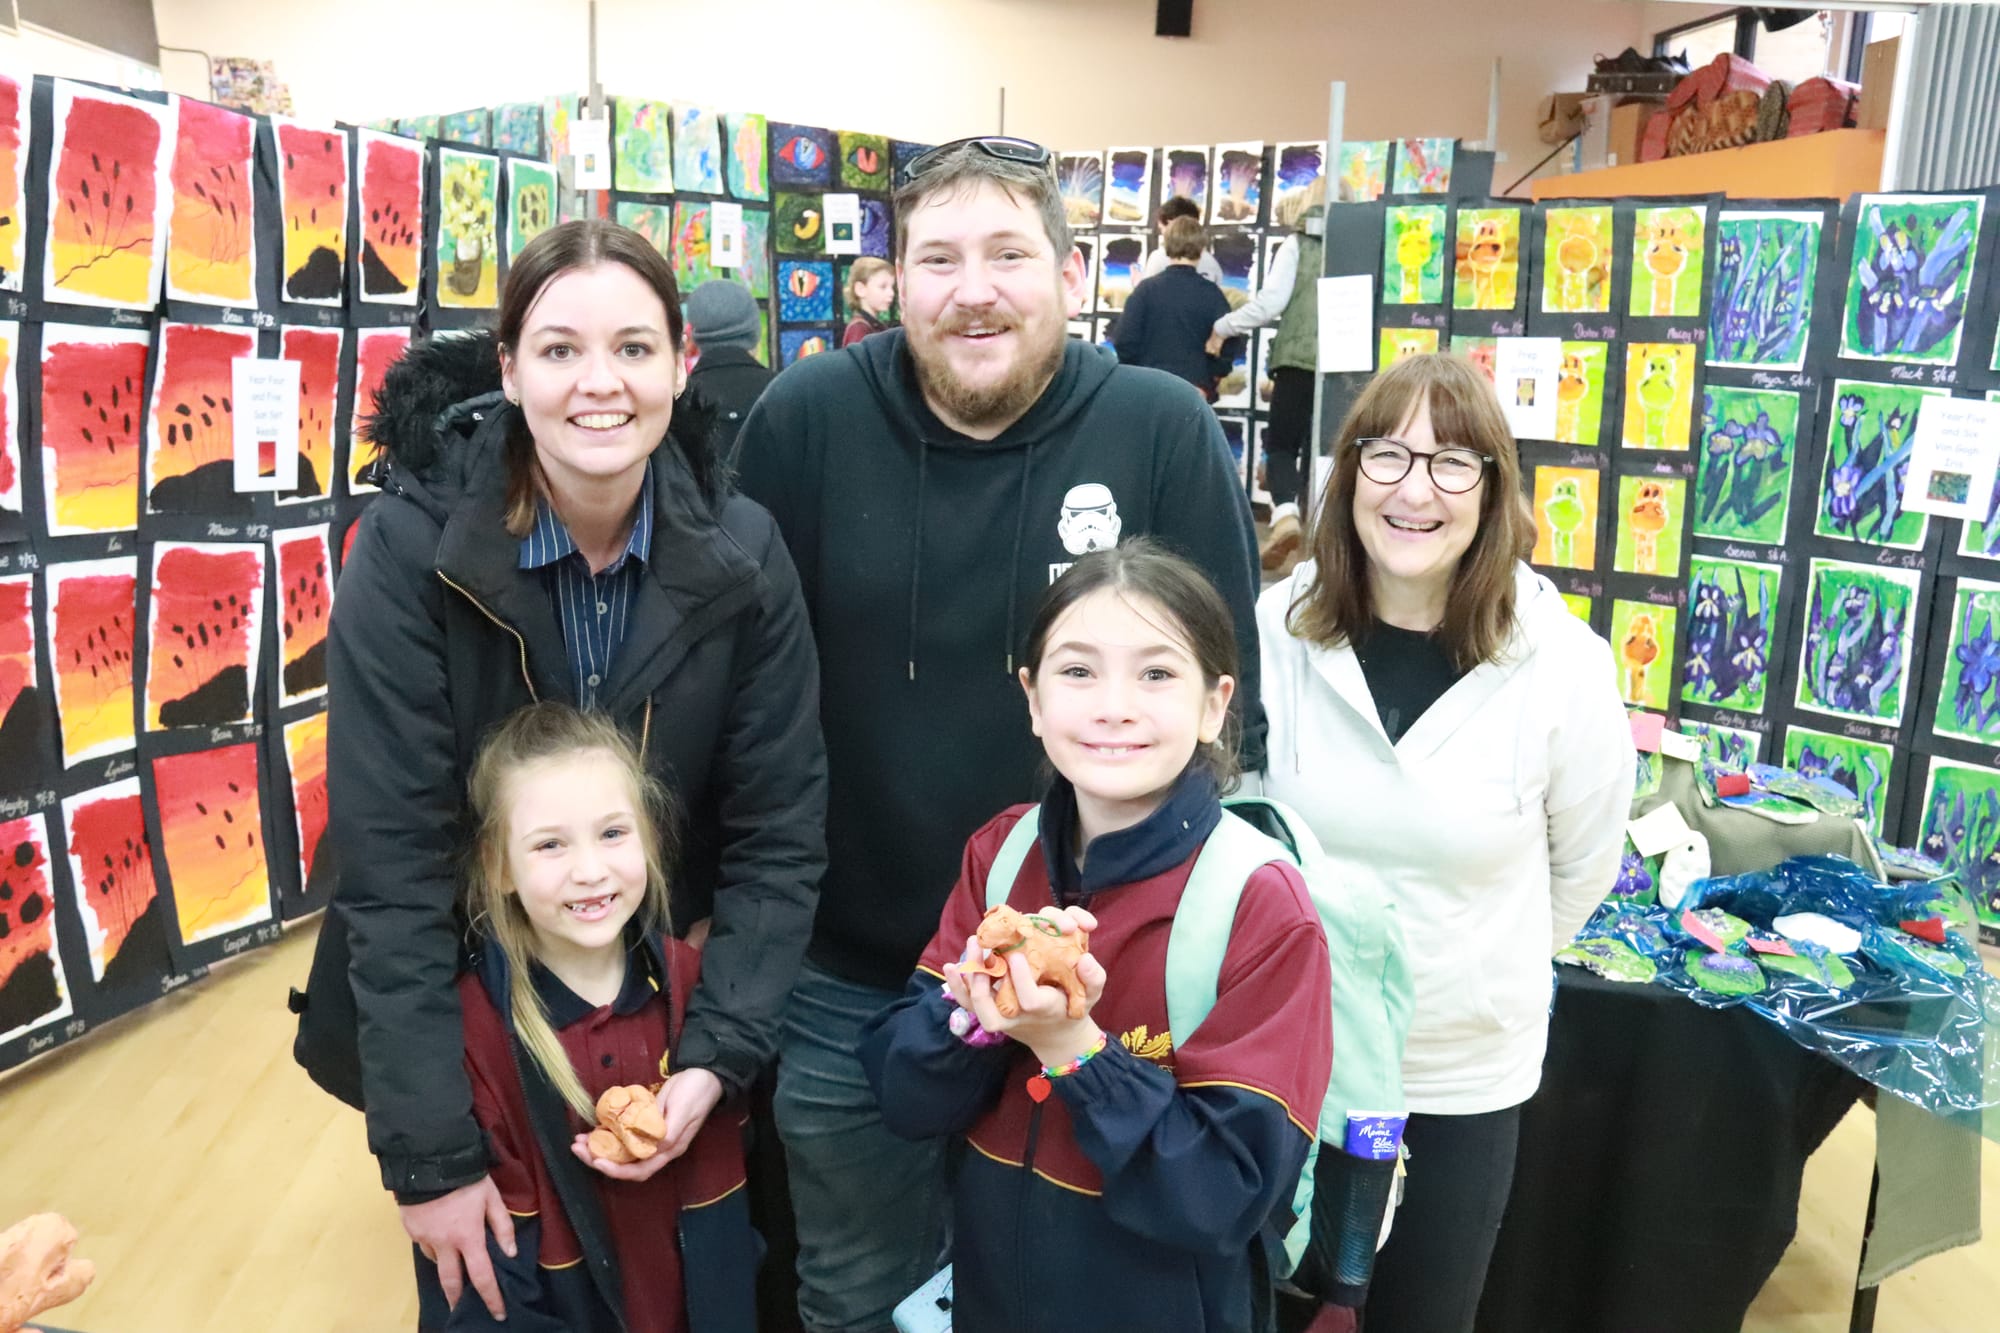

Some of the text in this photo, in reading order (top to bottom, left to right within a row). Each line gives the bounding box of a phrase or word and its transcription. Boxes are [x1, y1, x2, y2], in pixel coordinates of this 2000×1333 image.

[1940, 410, 1987, 424] Year Five
[1955, 443, 1980, 456] Gogh
